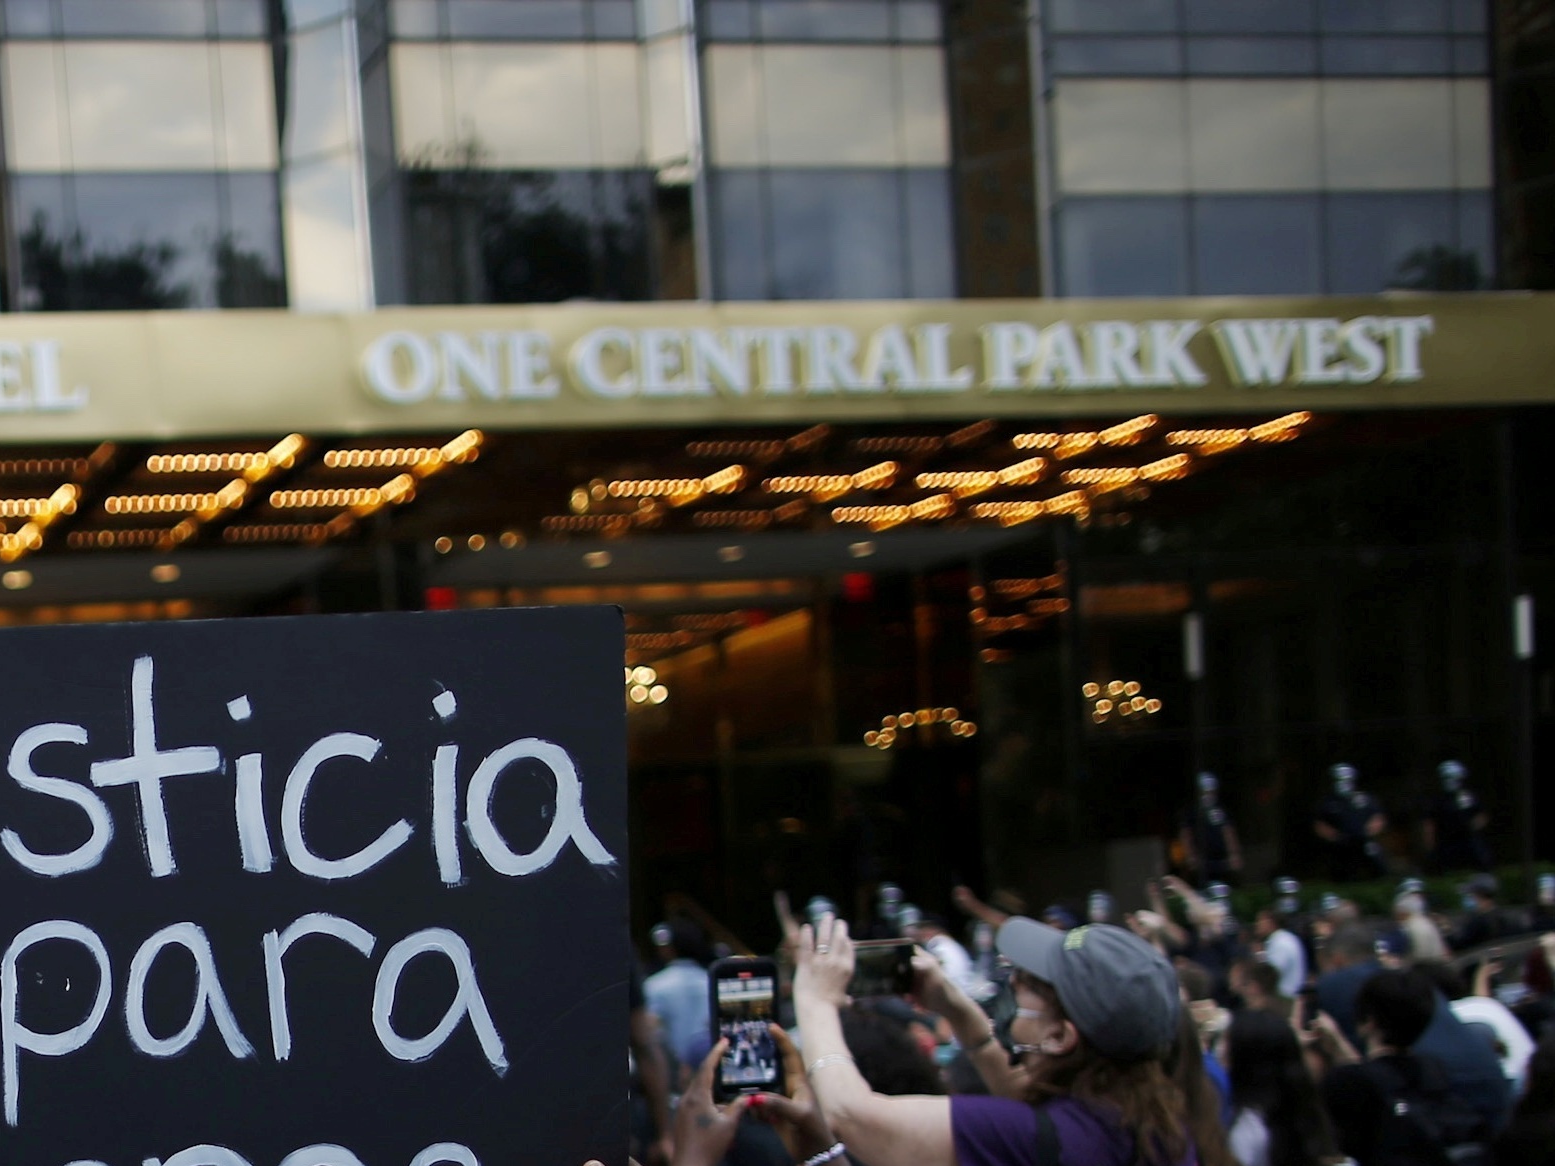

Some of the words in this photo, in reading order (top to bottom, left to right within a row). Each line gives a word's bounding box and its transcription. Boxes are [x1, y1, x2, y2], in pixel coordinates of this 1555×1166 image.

[362, 330, 560, 403] ONE
[566, 323, 974, 399] CENTRAL
[984, 318, 1208, 394] PARK
[1212, 314, 1434, 386] WEST
[0, 912, 510, 1127] para
